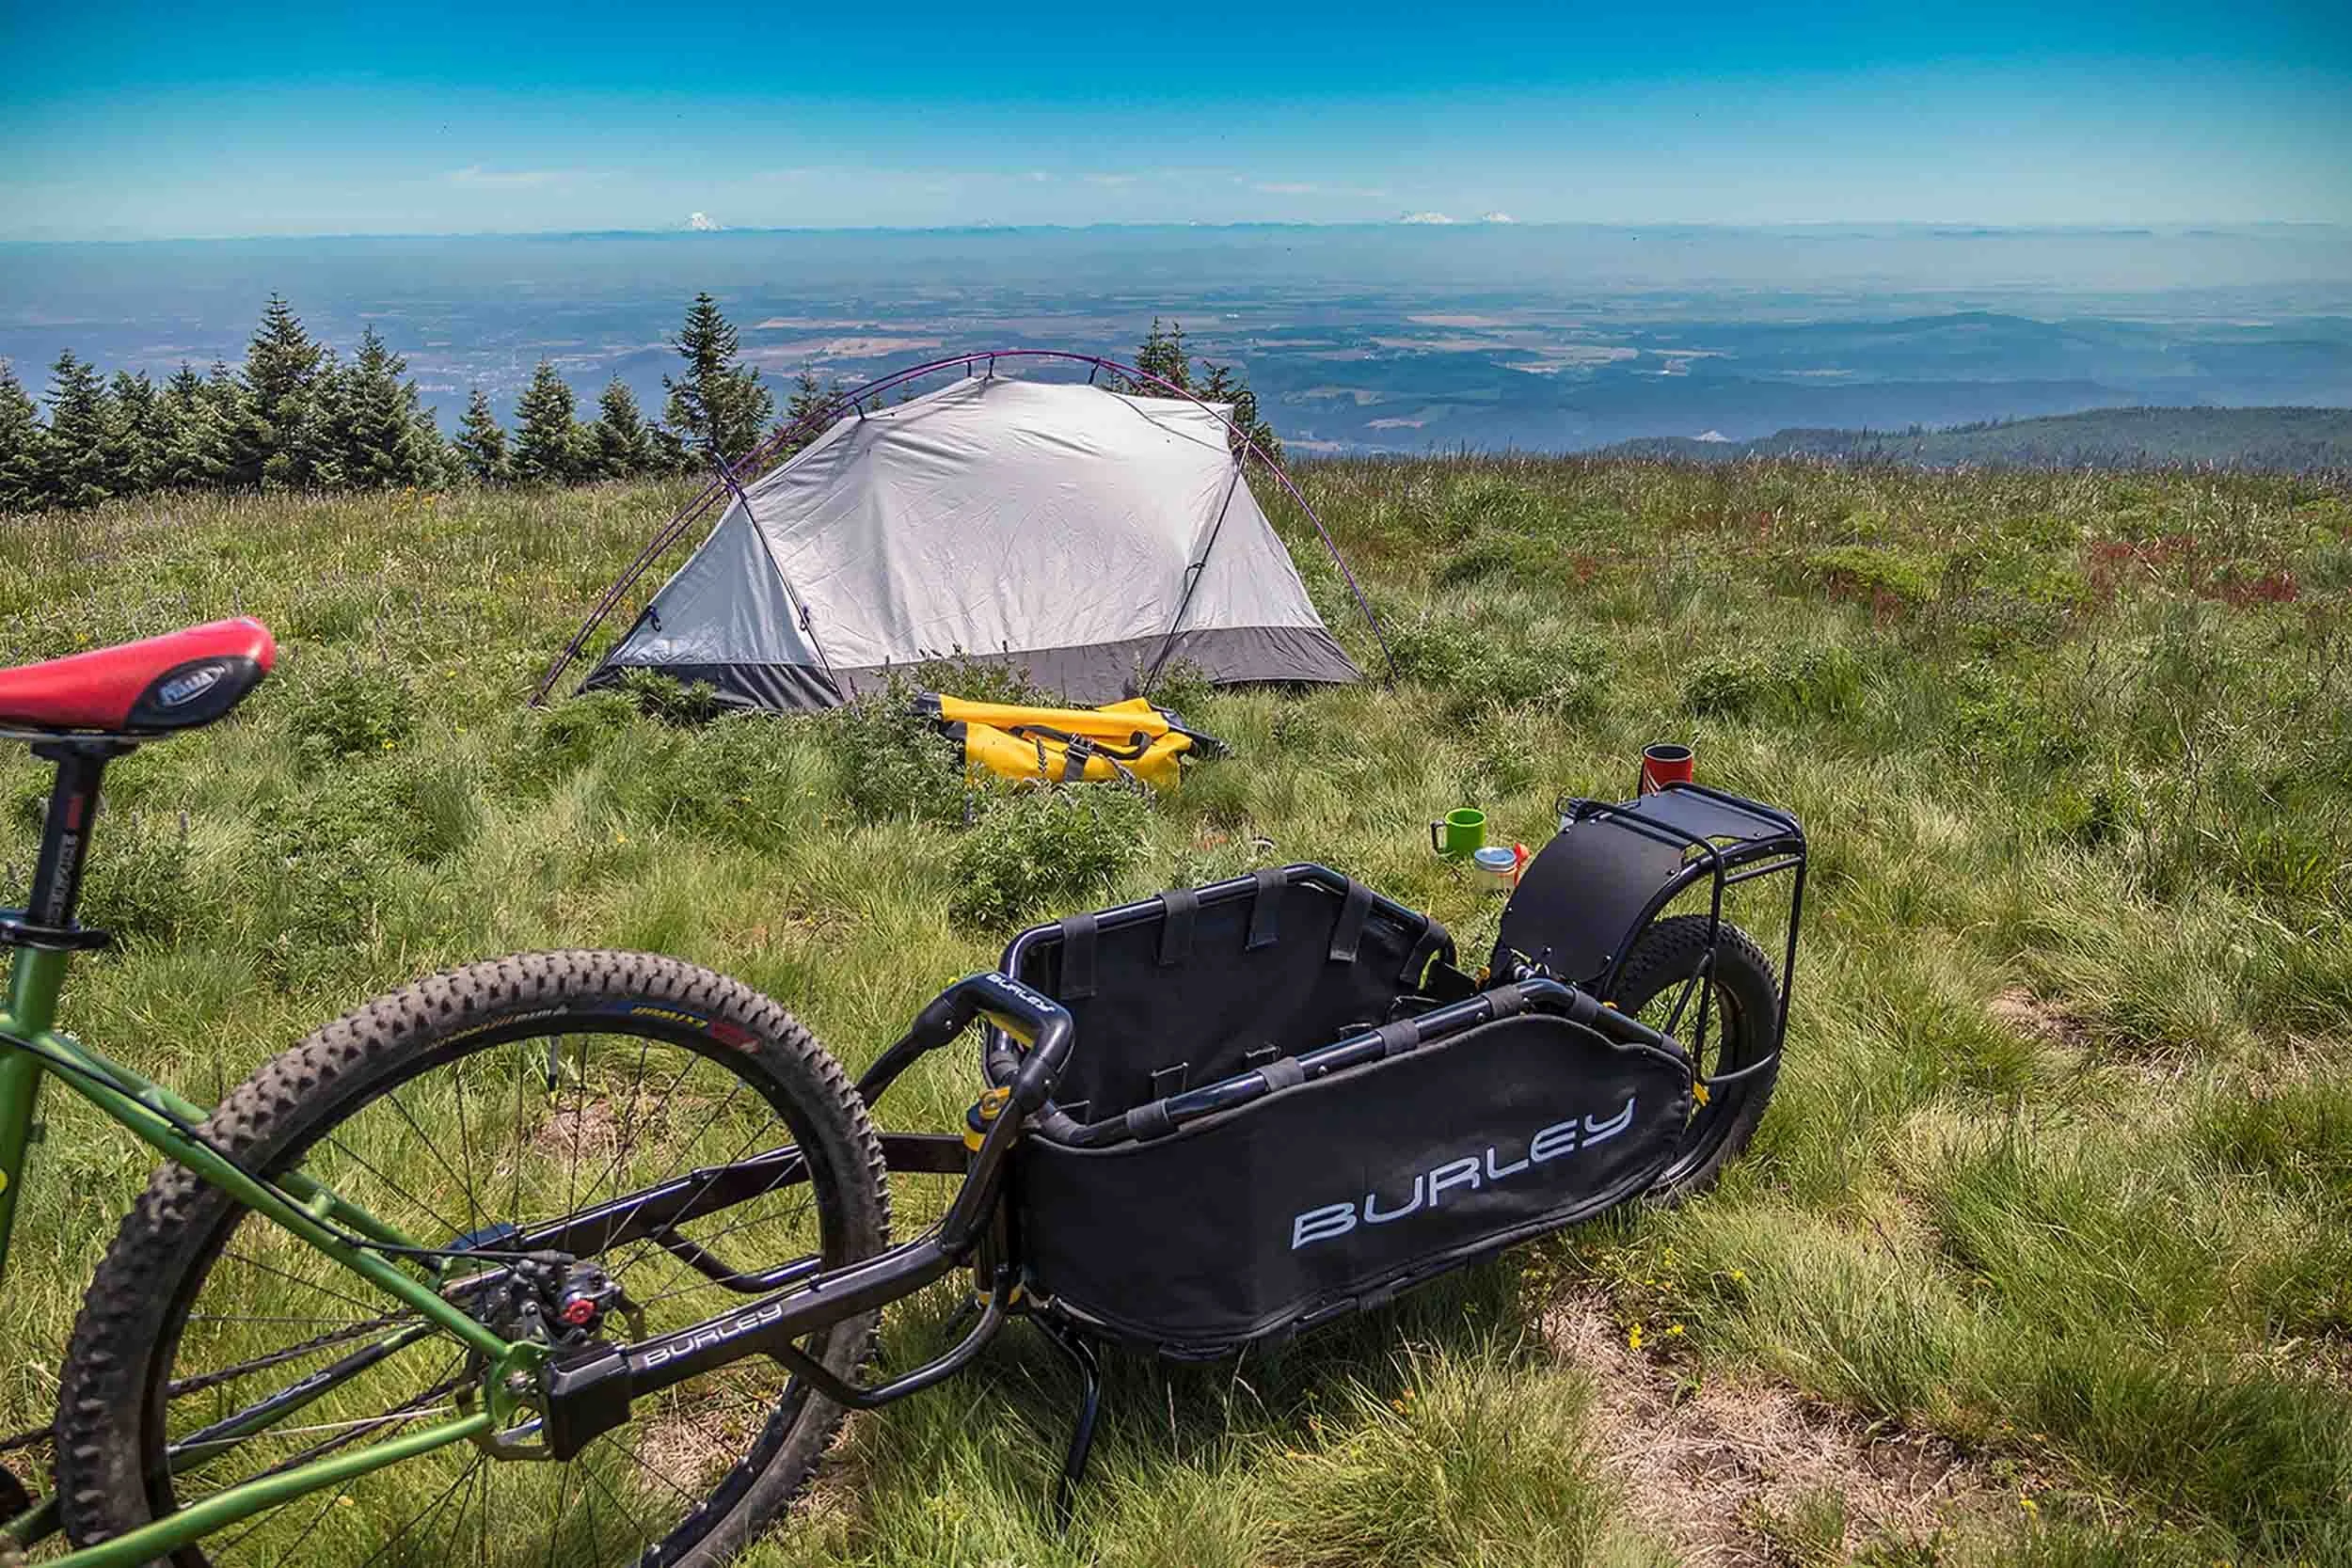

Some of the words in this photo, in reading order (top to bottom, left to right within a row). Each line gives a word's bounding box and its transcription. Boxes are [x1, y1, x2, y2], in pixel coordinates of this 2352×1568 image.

[985, 974, 1056, 1012] BURLEY
[1292, 1097, 1636, 1249] BURLEY
[644, 1303, 783, 1367] BURLEY
